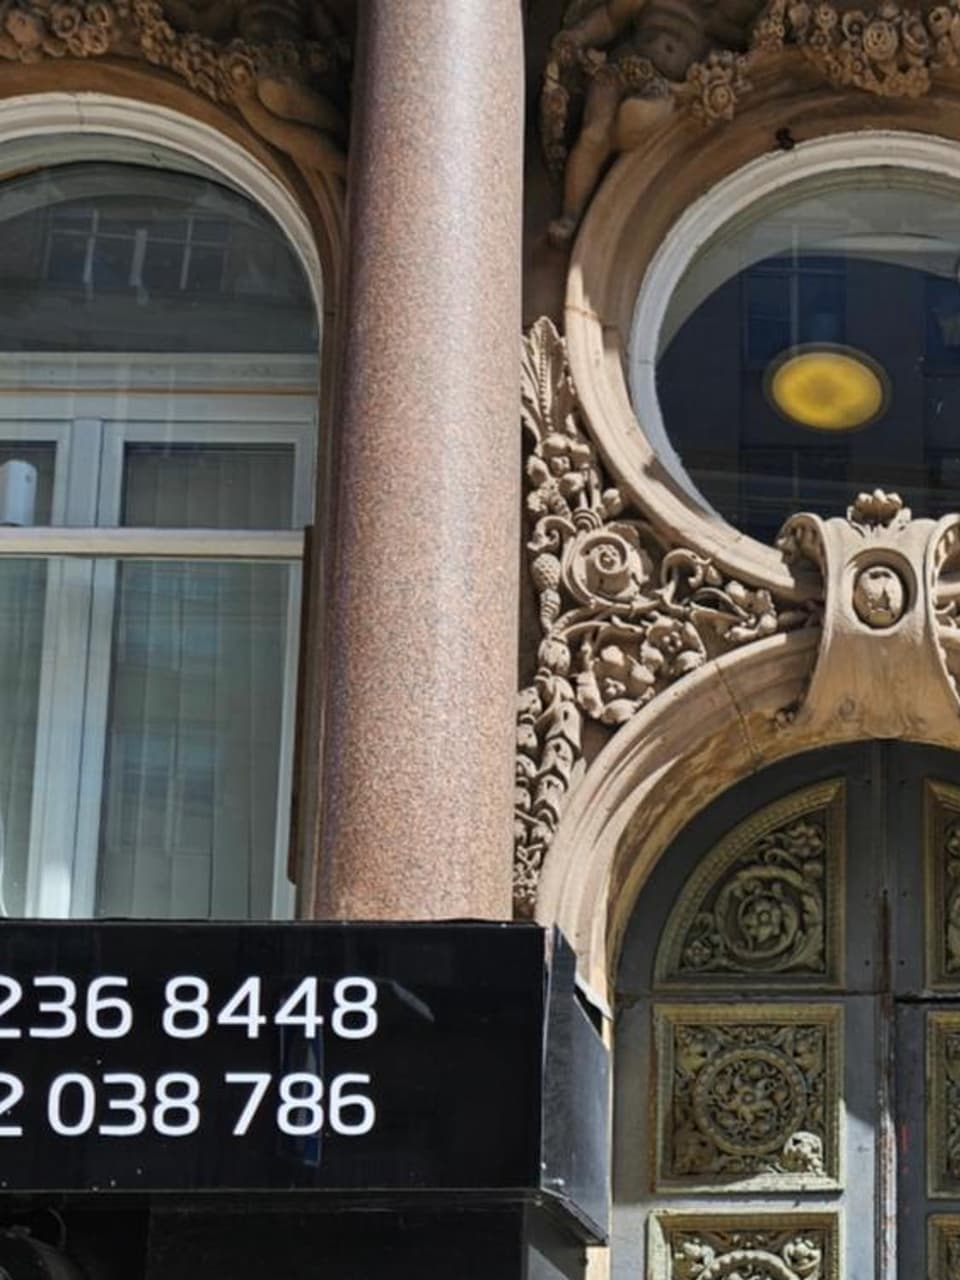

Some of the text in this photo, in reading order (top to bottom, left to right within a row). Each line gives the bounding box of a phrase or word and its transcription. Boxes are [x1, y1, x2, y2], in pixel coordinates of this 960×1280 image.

[162, 976, 378, 1039] 8448
[48, 1072, 200, 1136] 038
[225, 1072, 376, 1136] 786
